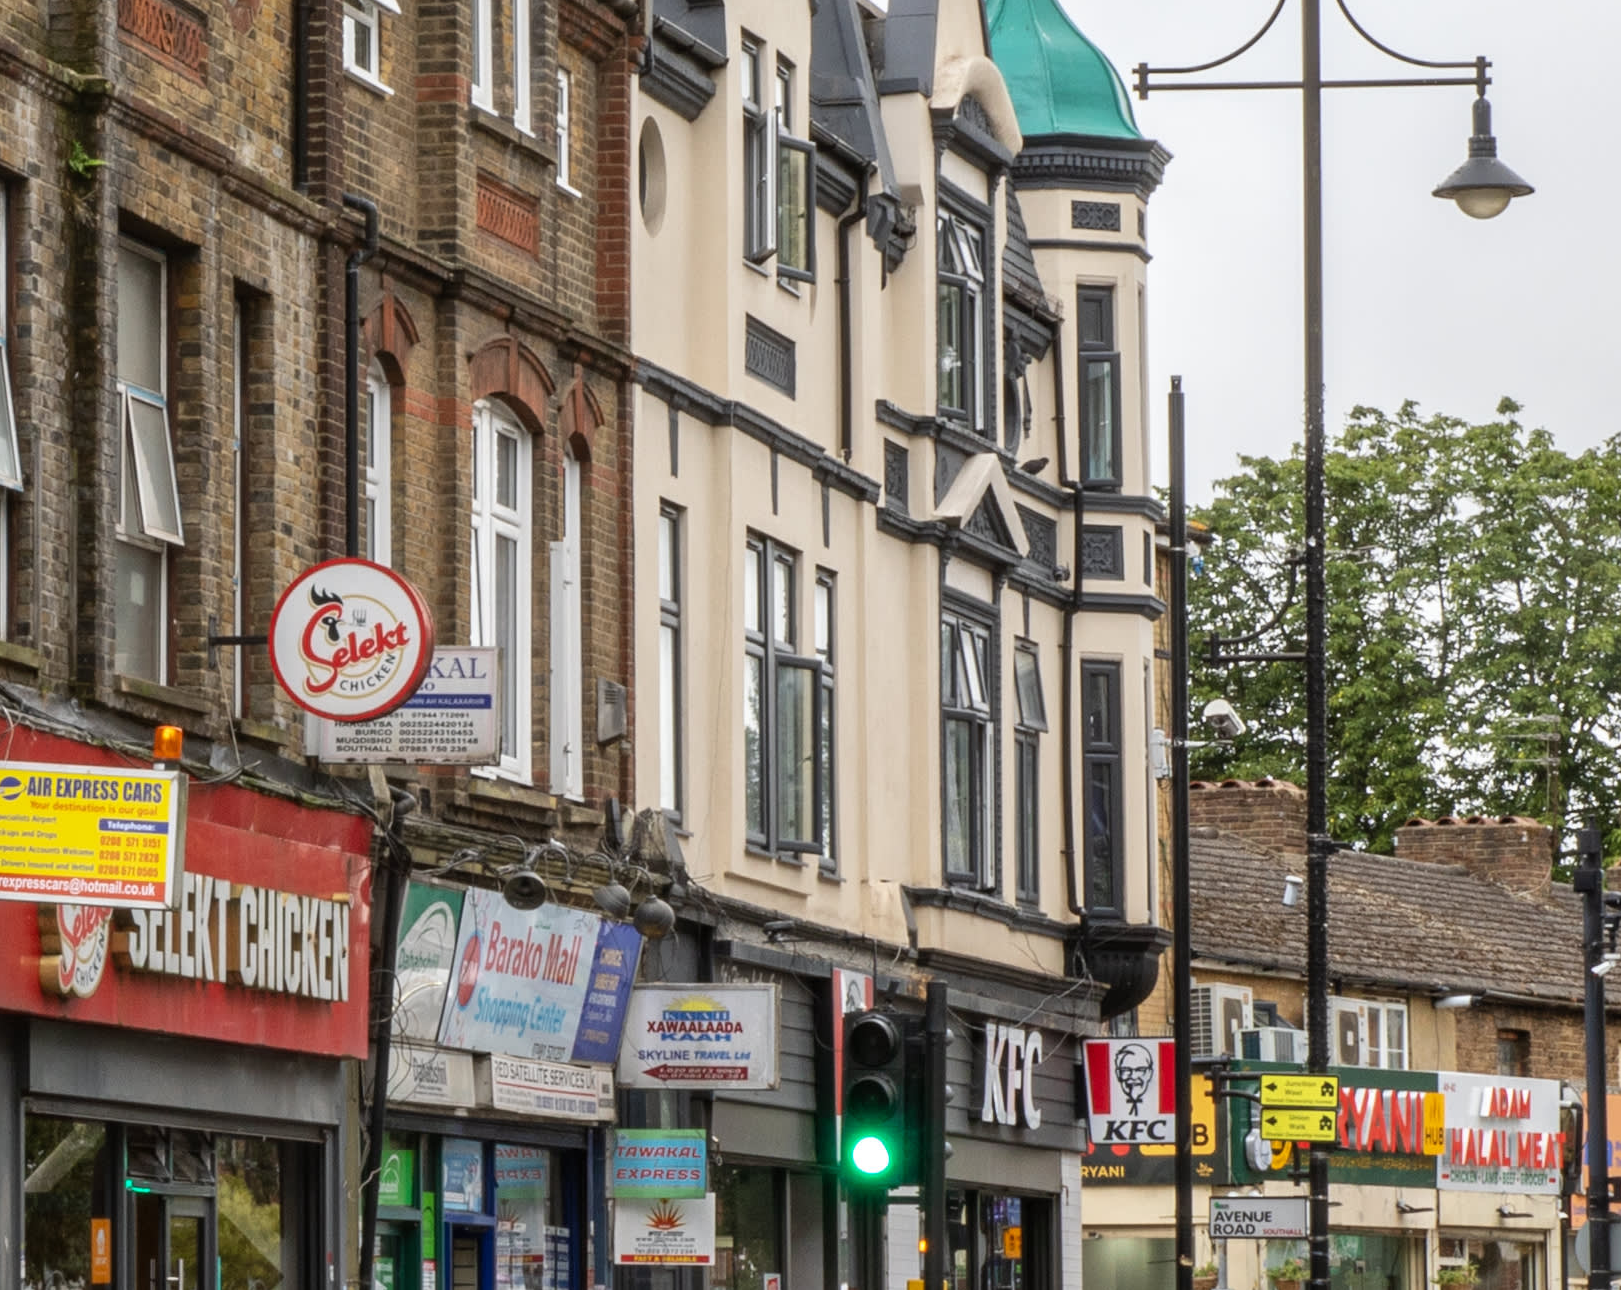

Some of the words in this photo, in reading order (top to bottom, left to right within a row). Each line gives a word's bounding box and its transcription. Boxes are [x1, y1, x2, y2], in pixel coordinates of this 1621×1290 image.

[302, 603, 410, 693] Selekt
[340, 653, 397, 691] CHICKEN
[27, 776, 52, 797] AIR
[56, 777, 119, 801] EXPRESS
[123, 781, 162, 804] CARS
[30, 801, 50, 810] Your
[52, 801, 106, 813] destination
[109, 806, 116, 814] is
[119, 806, 135, 815] our
[137, 806, 158, 818] goal
[32, 815, 57, 824] Airport
[107, 821, 156, 832] Telephone:
[22, 829, 35, 838] and
[37, 831, 57, 839] Drops
[29, 846, 60, 855] Accounts
[62, 846, 94, 856] Welcome
[2, 860, 26, 868] Drivers
[128, 871, 231, 983] SELEKT
[239, 885, 350, 1002] CHICKEN
[484, 920, 543, 980] Barako
[542, 933, 583, 986] Mall
[474, 986, 528, 1038] Shopping
[530, 993, 566, 1034] Center
[647, 1021, 743, 1033] XAWAALAADA
[638, 1050, 690, 1060] SKYLINE
[694, 1051, 731, 1059] TRAVEL
[735, 1051, 751, 1059] Ltd
[511, 1062, 549, 1084] SATELLITE
[550, 1067, 585, 1087] SERVICES
[981, 1023, 1043, 1131] KFC
[1488, 1086, 1531, 1119] ADAM
[1102, 1120, 1167, 1141] KFC
[1425, 1126, 1444, 1145] HUB
[617, 1146, 701, 1158] TAWAKAL
[1451, 1127, 1511, 1167] HALAL
[1518, 1131, 1566, 1169] MEAT
[616, 1169, 701, 1180] EXPRESS
[1450, 1170, 1478, 1183] CHICKEN
[1520, 1173, 1548, 1186] GROCERY
[1214, 1211, 1272, 1223] AVENUE
[1213, 1223, 1256, 1236] ROAD
[1263, 1228, 1303, 1236] SOUTHALL
